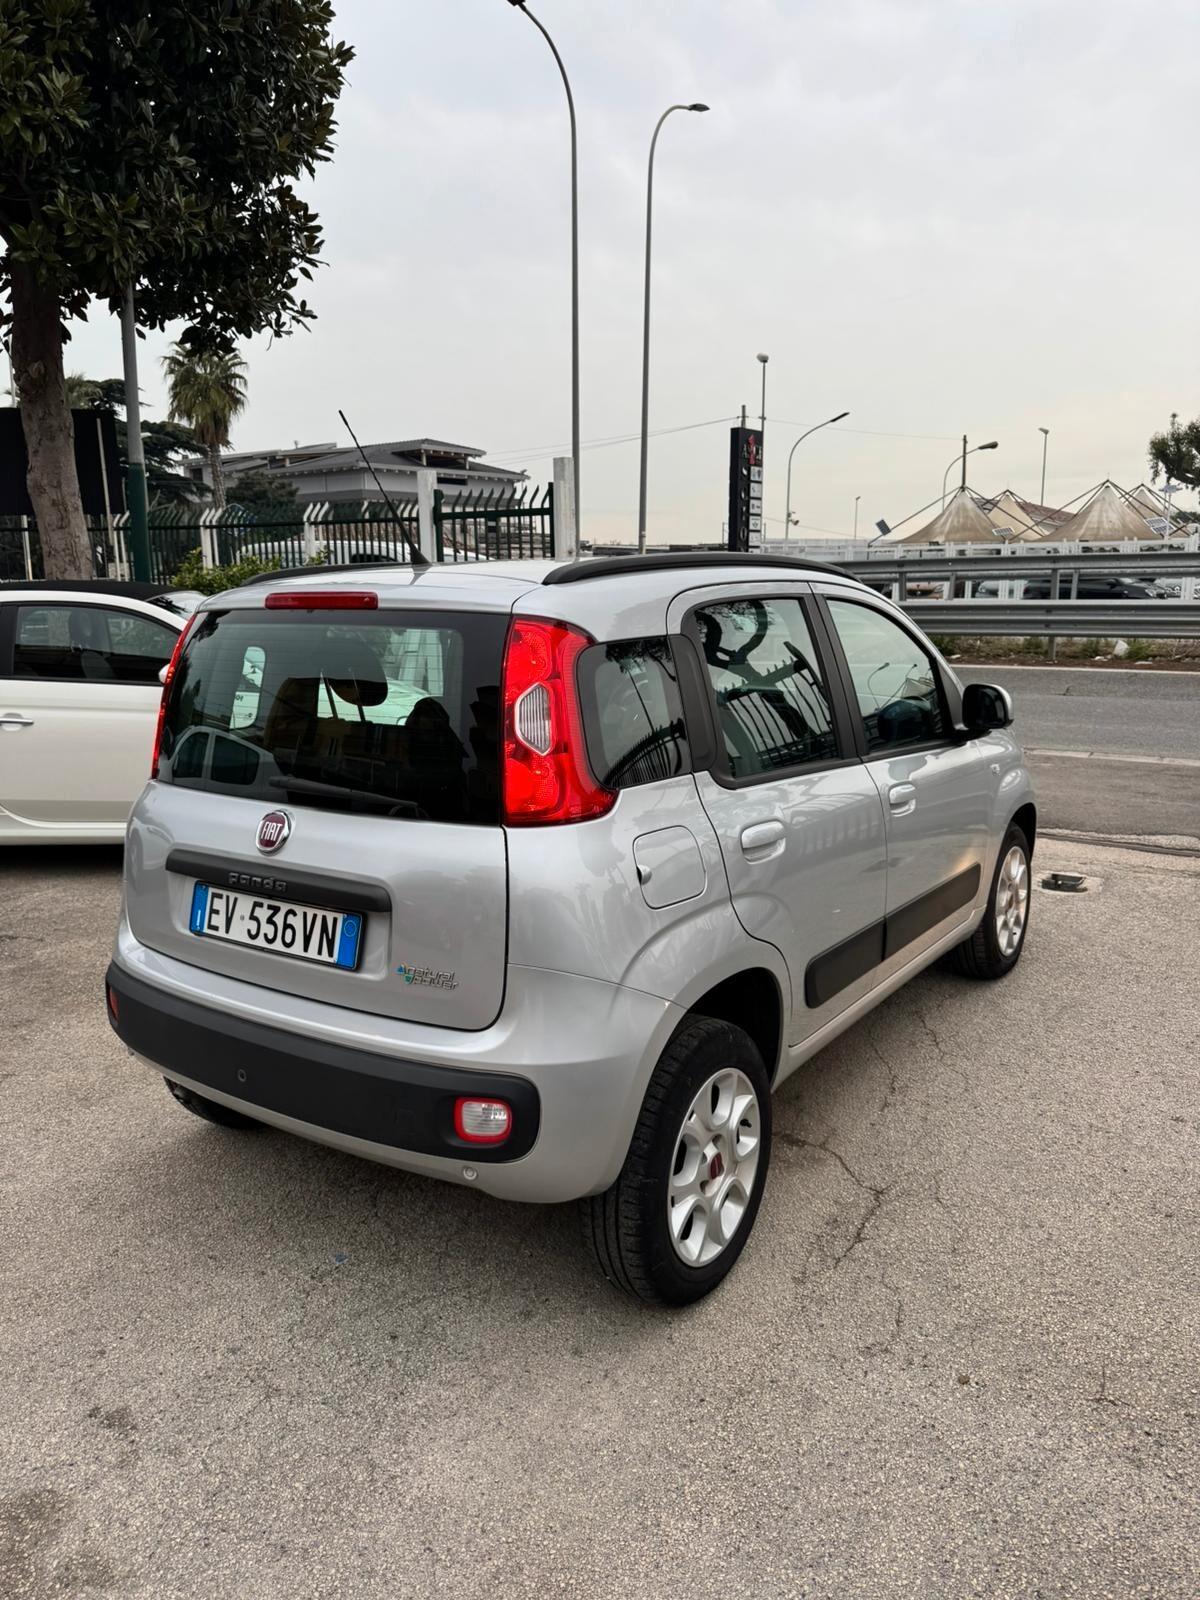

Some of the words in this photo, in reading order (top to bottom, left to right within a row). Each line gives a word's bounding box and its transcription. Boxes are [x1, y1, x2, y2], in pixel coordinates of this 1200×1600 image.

[260, 821, 283, 841] FIAT
[206, 891, 238, 935] EV
[247, 900, 338, 958] 536VN
[405, 966, 455, 981] natural
[411, 976, 458, 990] power
